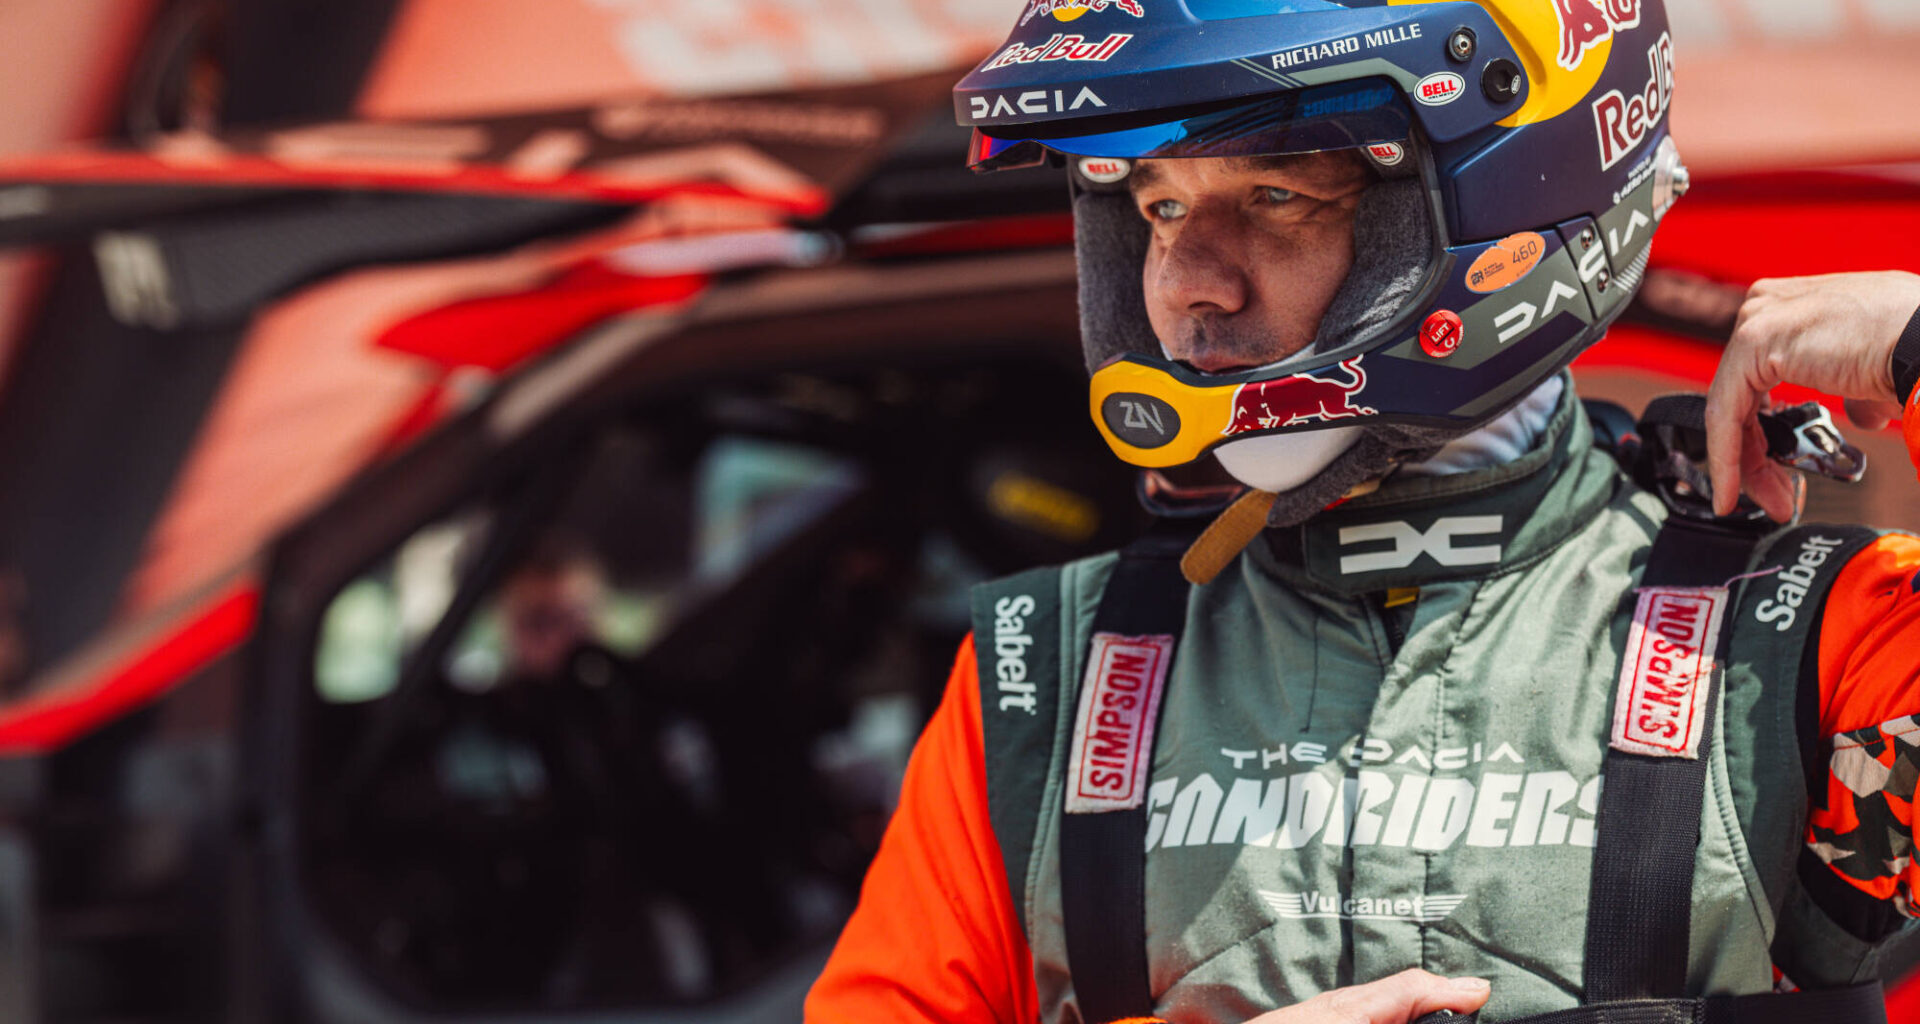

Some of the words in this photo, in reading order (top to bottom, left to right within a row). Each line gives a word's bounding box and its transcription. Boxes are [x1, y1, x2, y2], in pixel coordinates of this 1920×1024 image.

[1041, 33, 1132, 61] Bull
[1272, 37, 1360, 69] RICHARD
[1365, 23, 1422, 48] MILLE
[971, 86, 1107, 119] DACIA
[1422, 80, 1457, 97] BELL
[1087, 162, 1119, 174] BELL
[1512, 240, 1537, 263] 460
[1431, 322, 1449, 342] LIFT
[1755, 534, 1844, 632] Sabelt
[995, 594, 1037, 714] Sabelt
[1089, 652, 1148, 791] SIMPSON
[1221, 741, 1329, 770] THE
[1349, 738, 1525, 769] DACIA
[1301, 890, 1424, 918] Vulcanet
